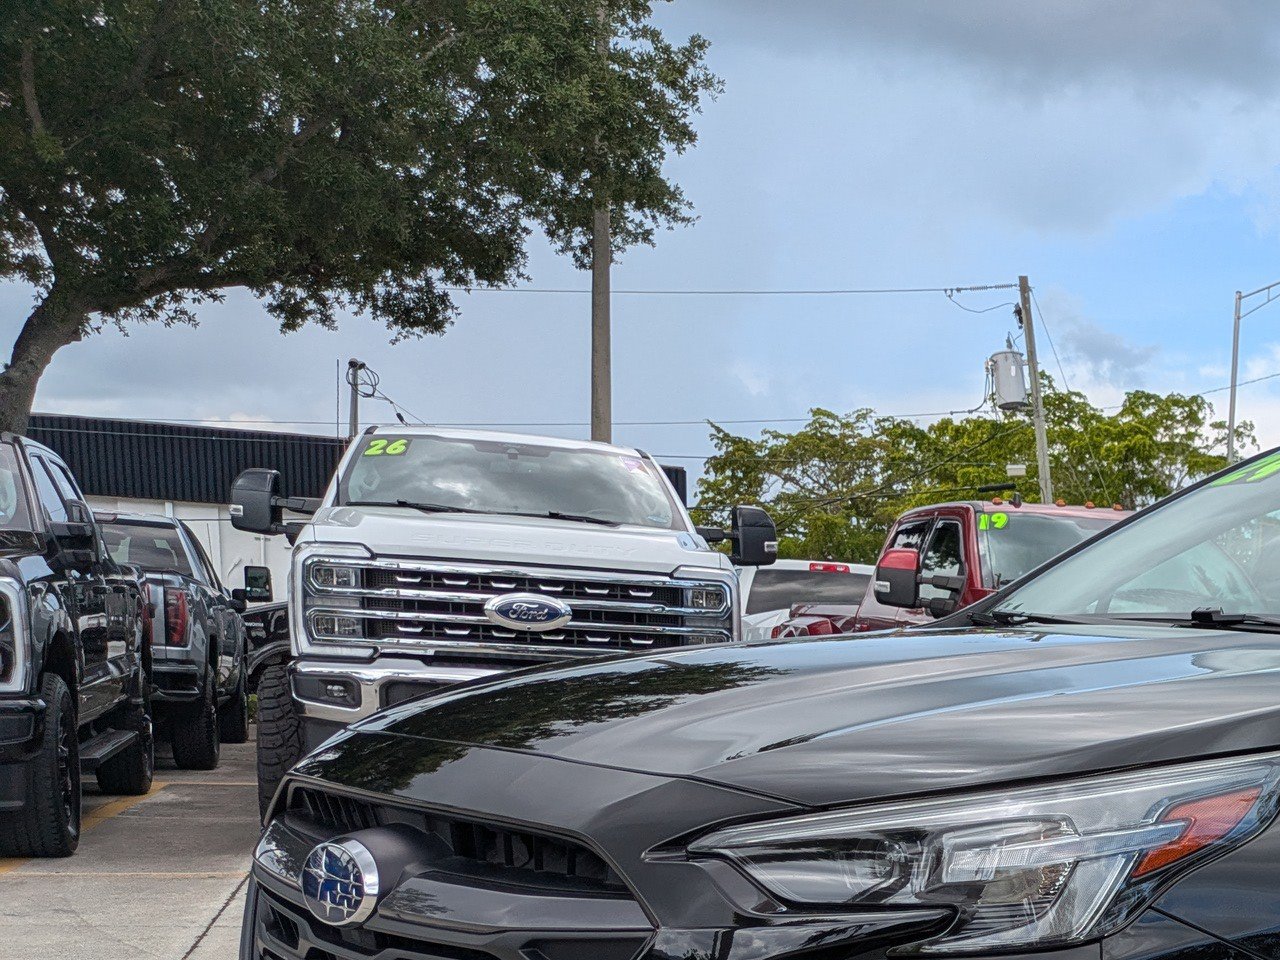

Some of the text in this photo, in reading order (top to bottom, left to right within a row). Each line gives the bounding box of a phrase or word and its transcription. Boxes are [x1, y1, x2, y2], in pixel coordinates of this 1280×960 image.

[363, 438, 409, 456] 26
[978, 512, 1009, 530] 19
[507, 602, 549, 620] Ford
